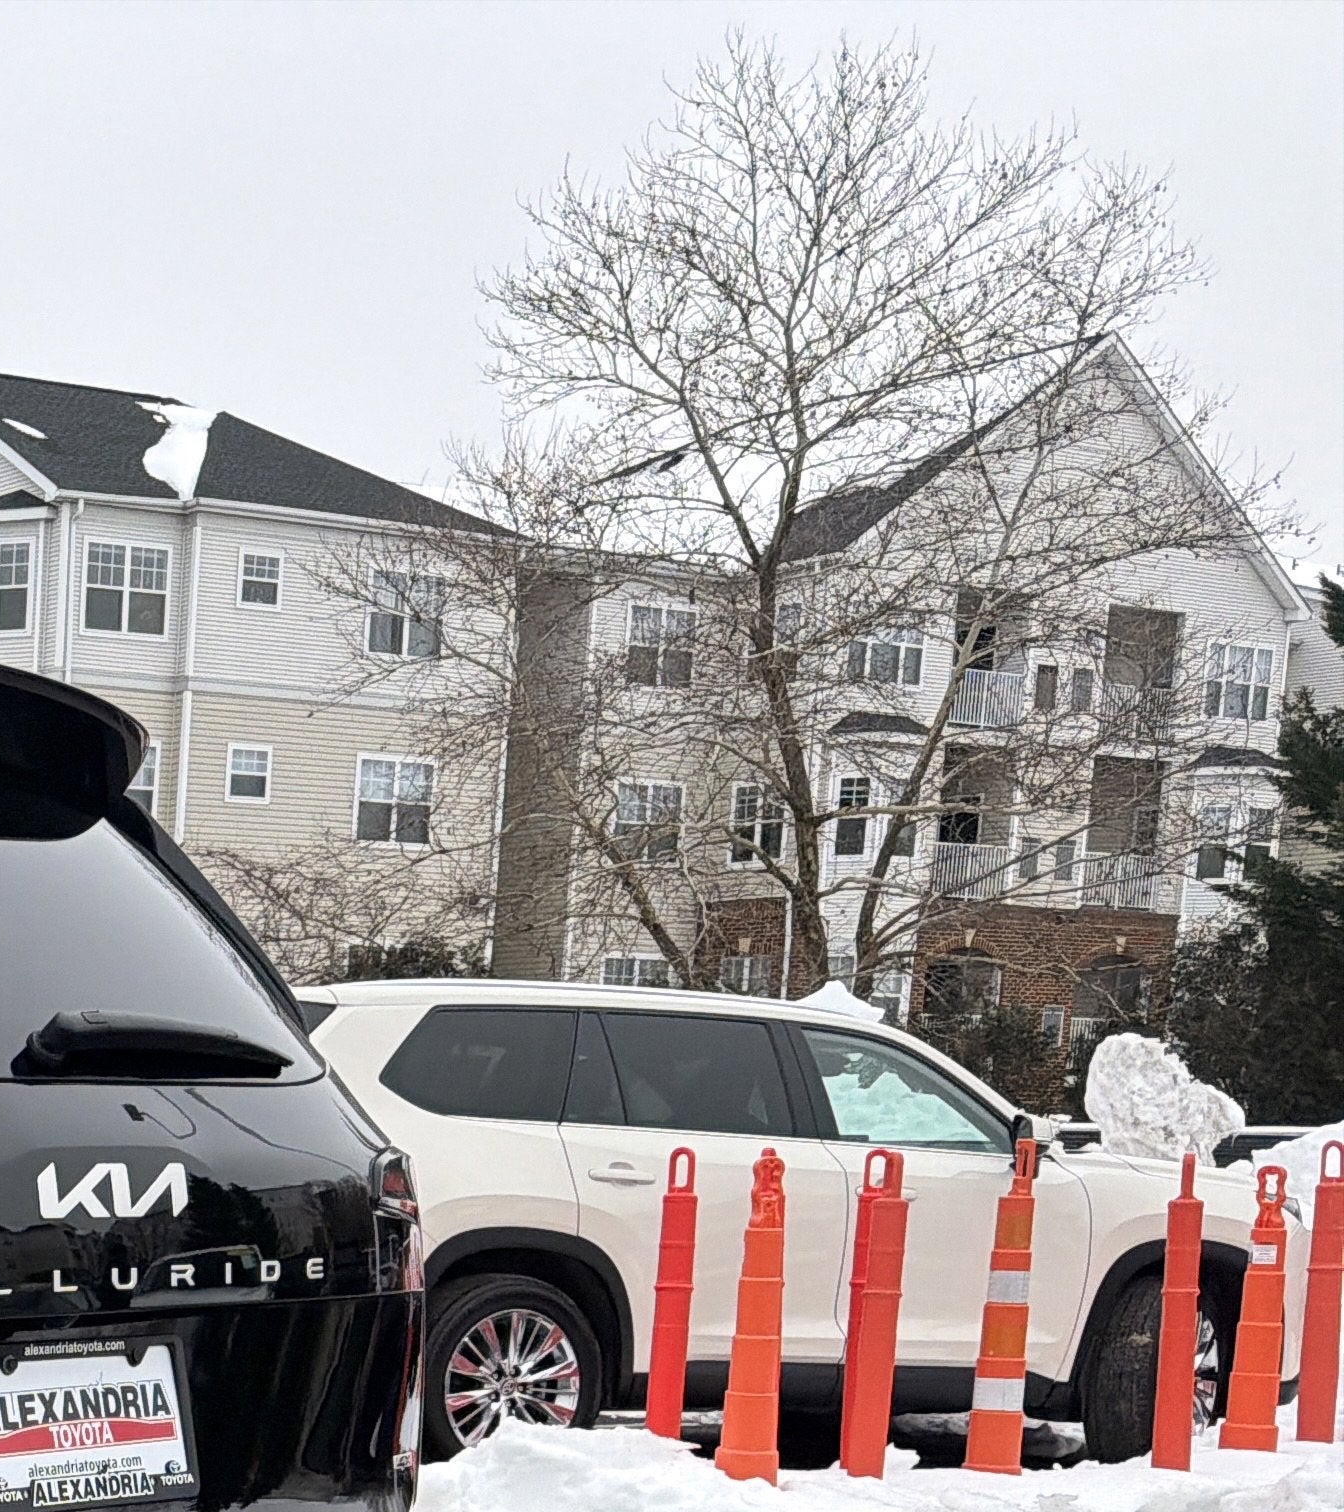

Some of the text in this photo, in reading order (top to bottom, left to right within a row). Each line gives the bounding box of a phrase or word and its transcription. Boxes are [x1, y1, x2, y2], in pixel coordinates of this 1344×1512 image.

[36, 1162, 189, 1219] KIA
[24, 1340, 125, 1356] alexandriatoyota.com
[49, 1421, 114, 1448] TOYOTA
[28, 1455, 142, 1478] alexandriatoyota.com
[32, 1472, 154, 1507] ALEXANDRIA
[160, 1474, 194, 1486] TOYOTA
